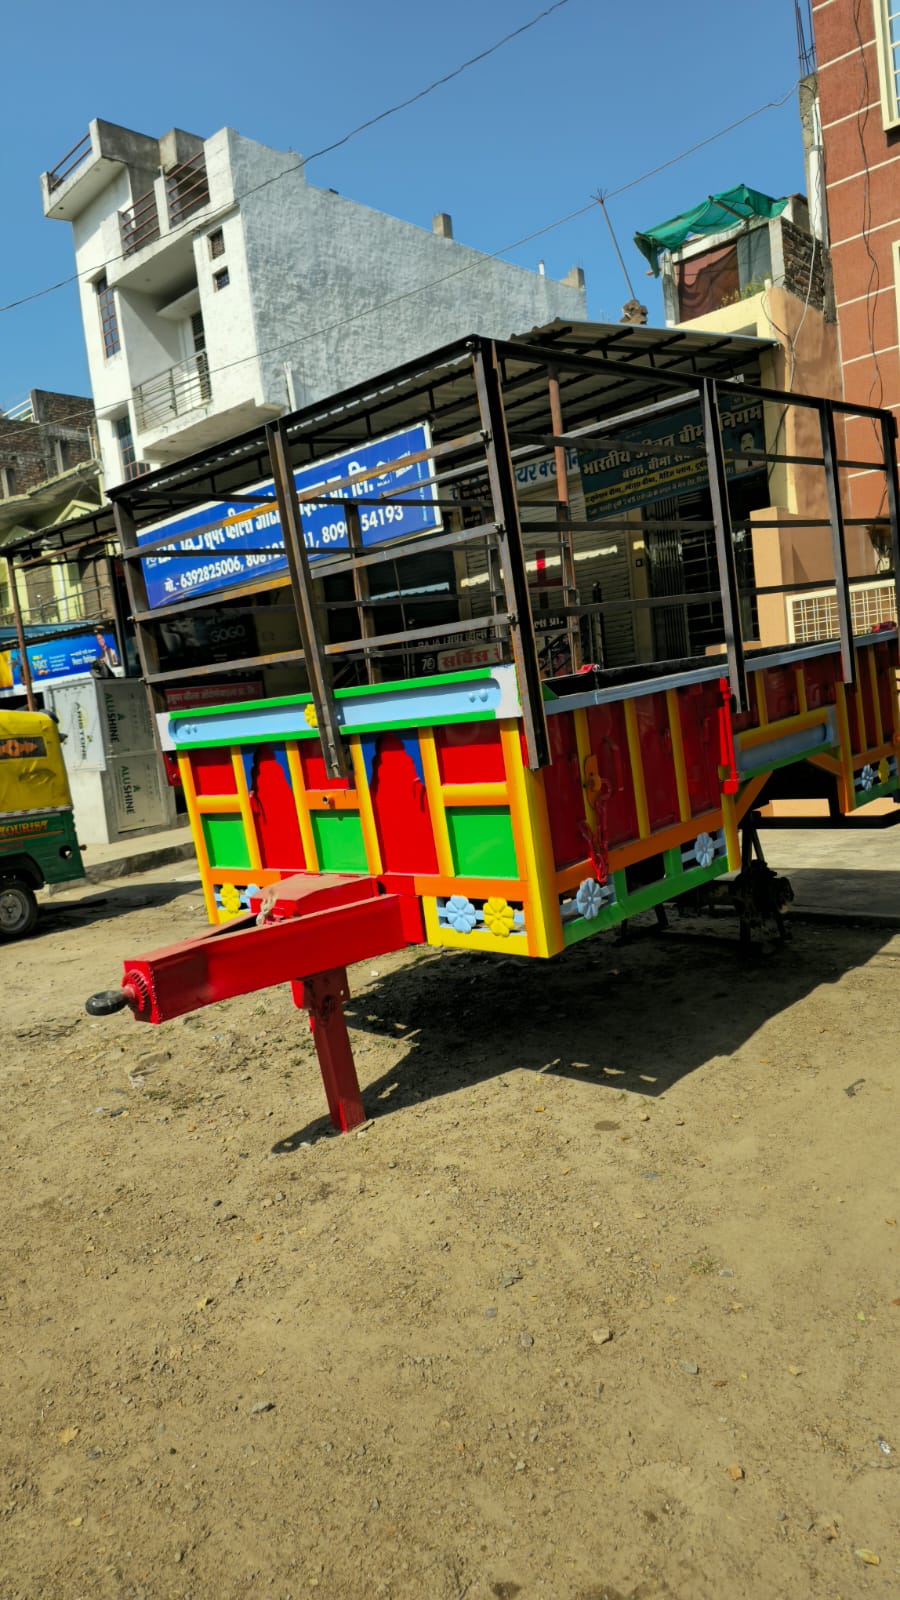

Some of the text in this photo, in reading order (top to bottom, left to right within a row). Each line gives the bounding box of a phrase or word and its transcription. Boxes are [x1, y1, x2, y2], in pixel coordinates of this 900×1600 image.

[582, 449, 631, 475] भारतीय
[442, 650, 489, 668] सर्विस
[104, 692, 120, 744] ALUSHINE
[120, 765, 136, 816] ALUSHINE
